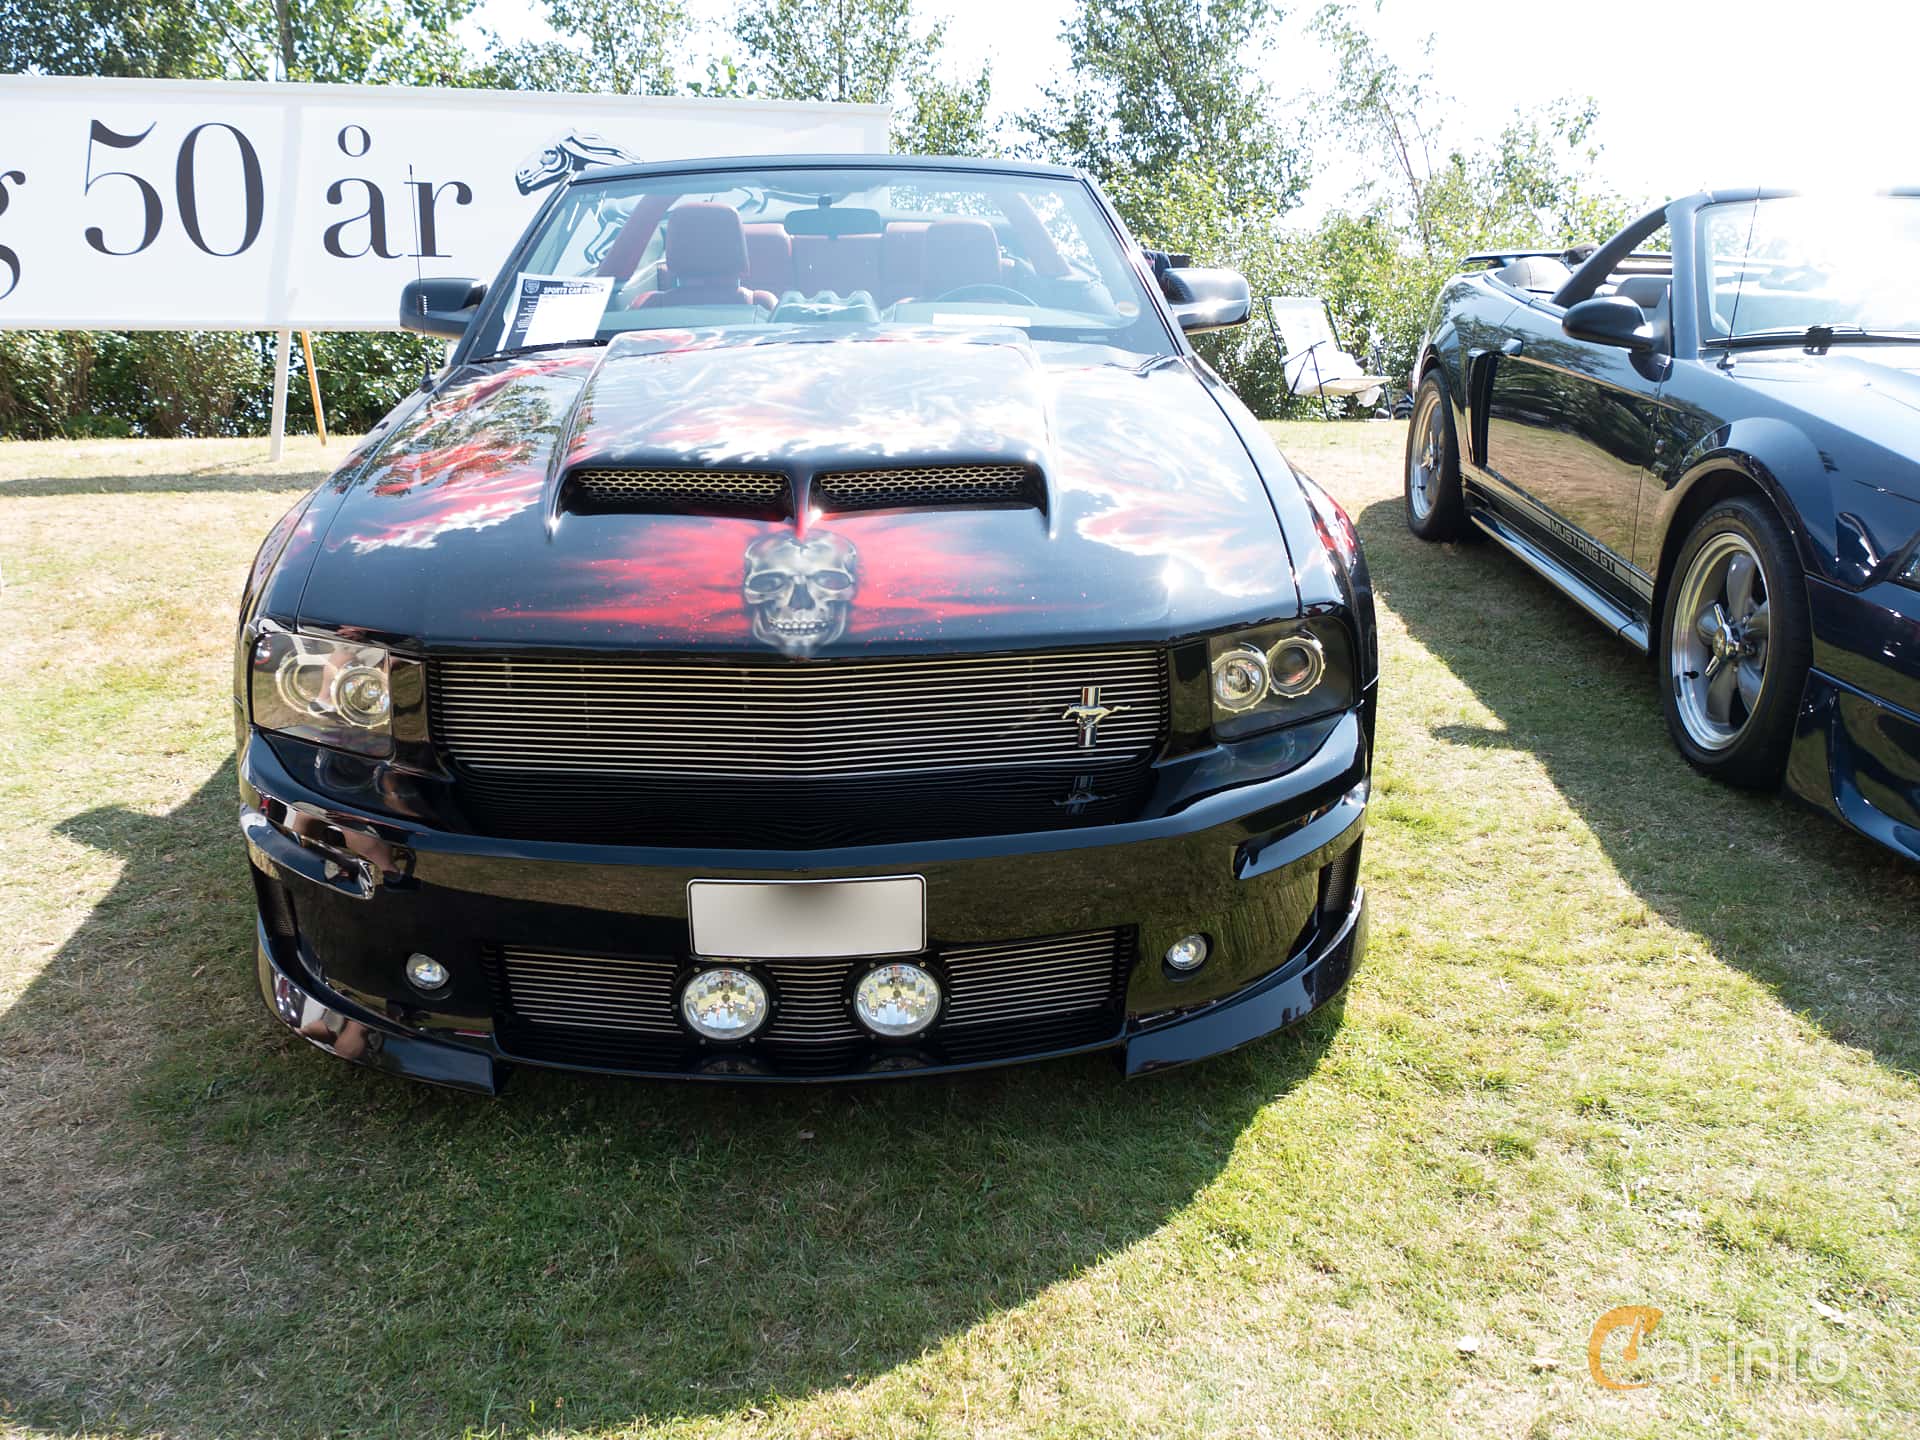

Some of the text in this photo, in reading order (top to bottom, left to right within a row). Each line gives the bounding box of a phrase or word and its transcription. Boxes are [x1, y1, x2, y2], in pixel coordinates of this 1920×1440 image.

[83, 118, 264, 257] 50
[323, 124, 473, 259] år
[1552, 520, 1614, 571] MUSTANG GT
